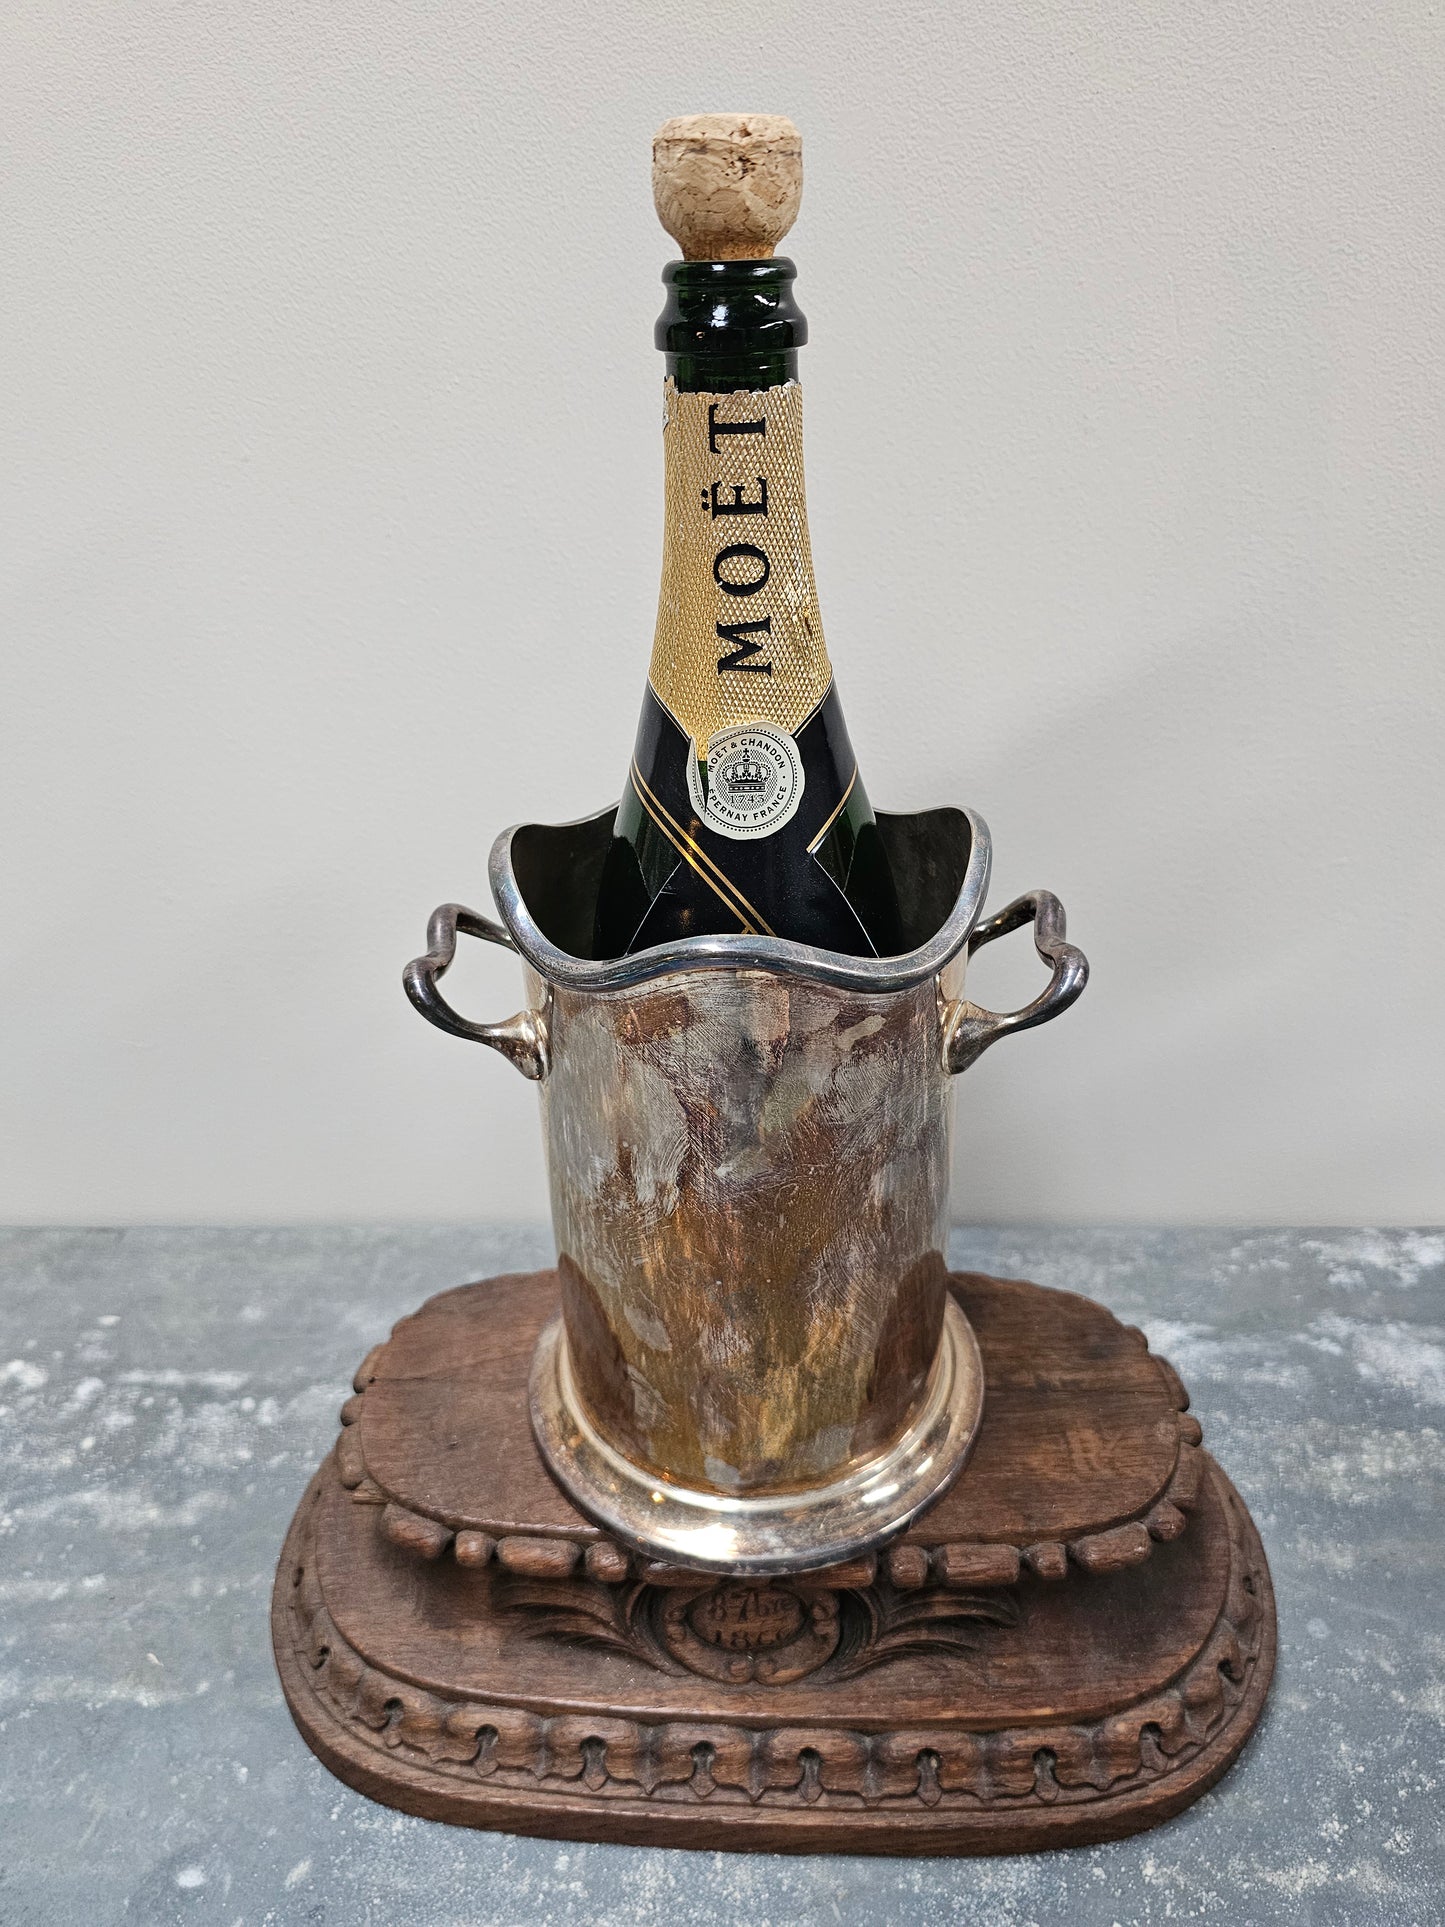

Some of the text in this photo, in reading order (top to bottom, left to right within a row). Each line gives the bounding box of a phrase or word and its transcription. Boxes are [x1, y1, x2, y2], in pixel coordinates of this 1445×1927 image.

[701, 403, 772, 677] MOËT
[708, 746, 728, 772] MOËT
[740, 738, 786, 769] CHANDON
[730, 795, 765, 804] 1743
[753, 786, 787, 821] FRANCE
